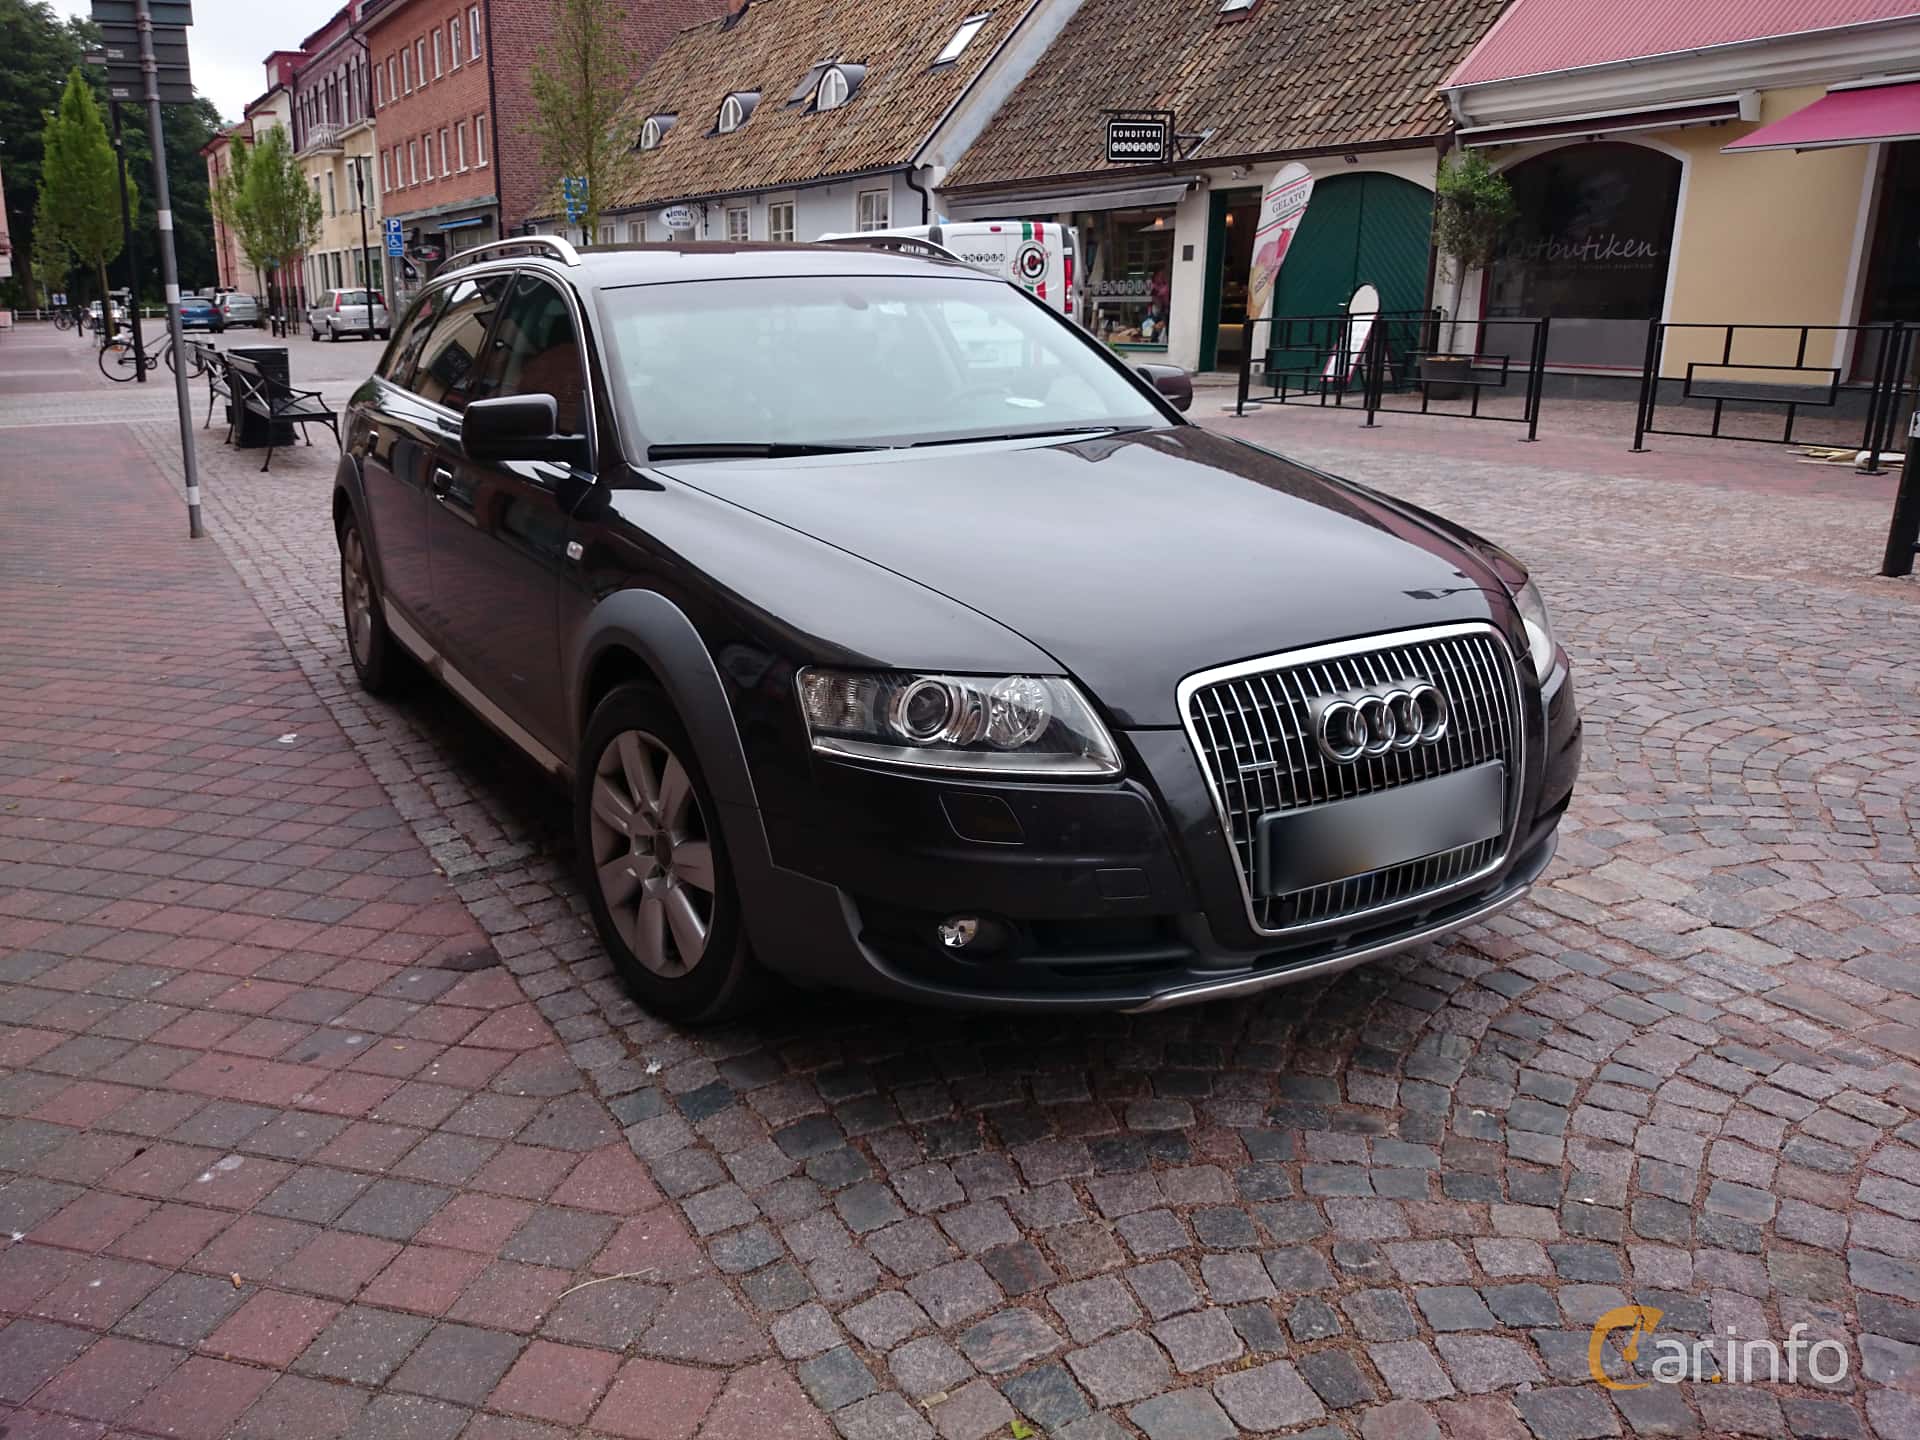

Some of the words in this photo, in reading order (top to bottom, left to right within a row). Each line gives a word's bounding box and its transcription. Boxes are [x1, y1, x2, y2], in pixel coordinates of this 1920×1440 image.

[1113, 130, 1160, 138] KONDITORI
[1112, 142, 1160, 152] CENTRUM
[1272, 190, 1306, 213] GELATO
[390, 221, 399, 232] P
[960, 253, 1006, 262] ENTRUM
